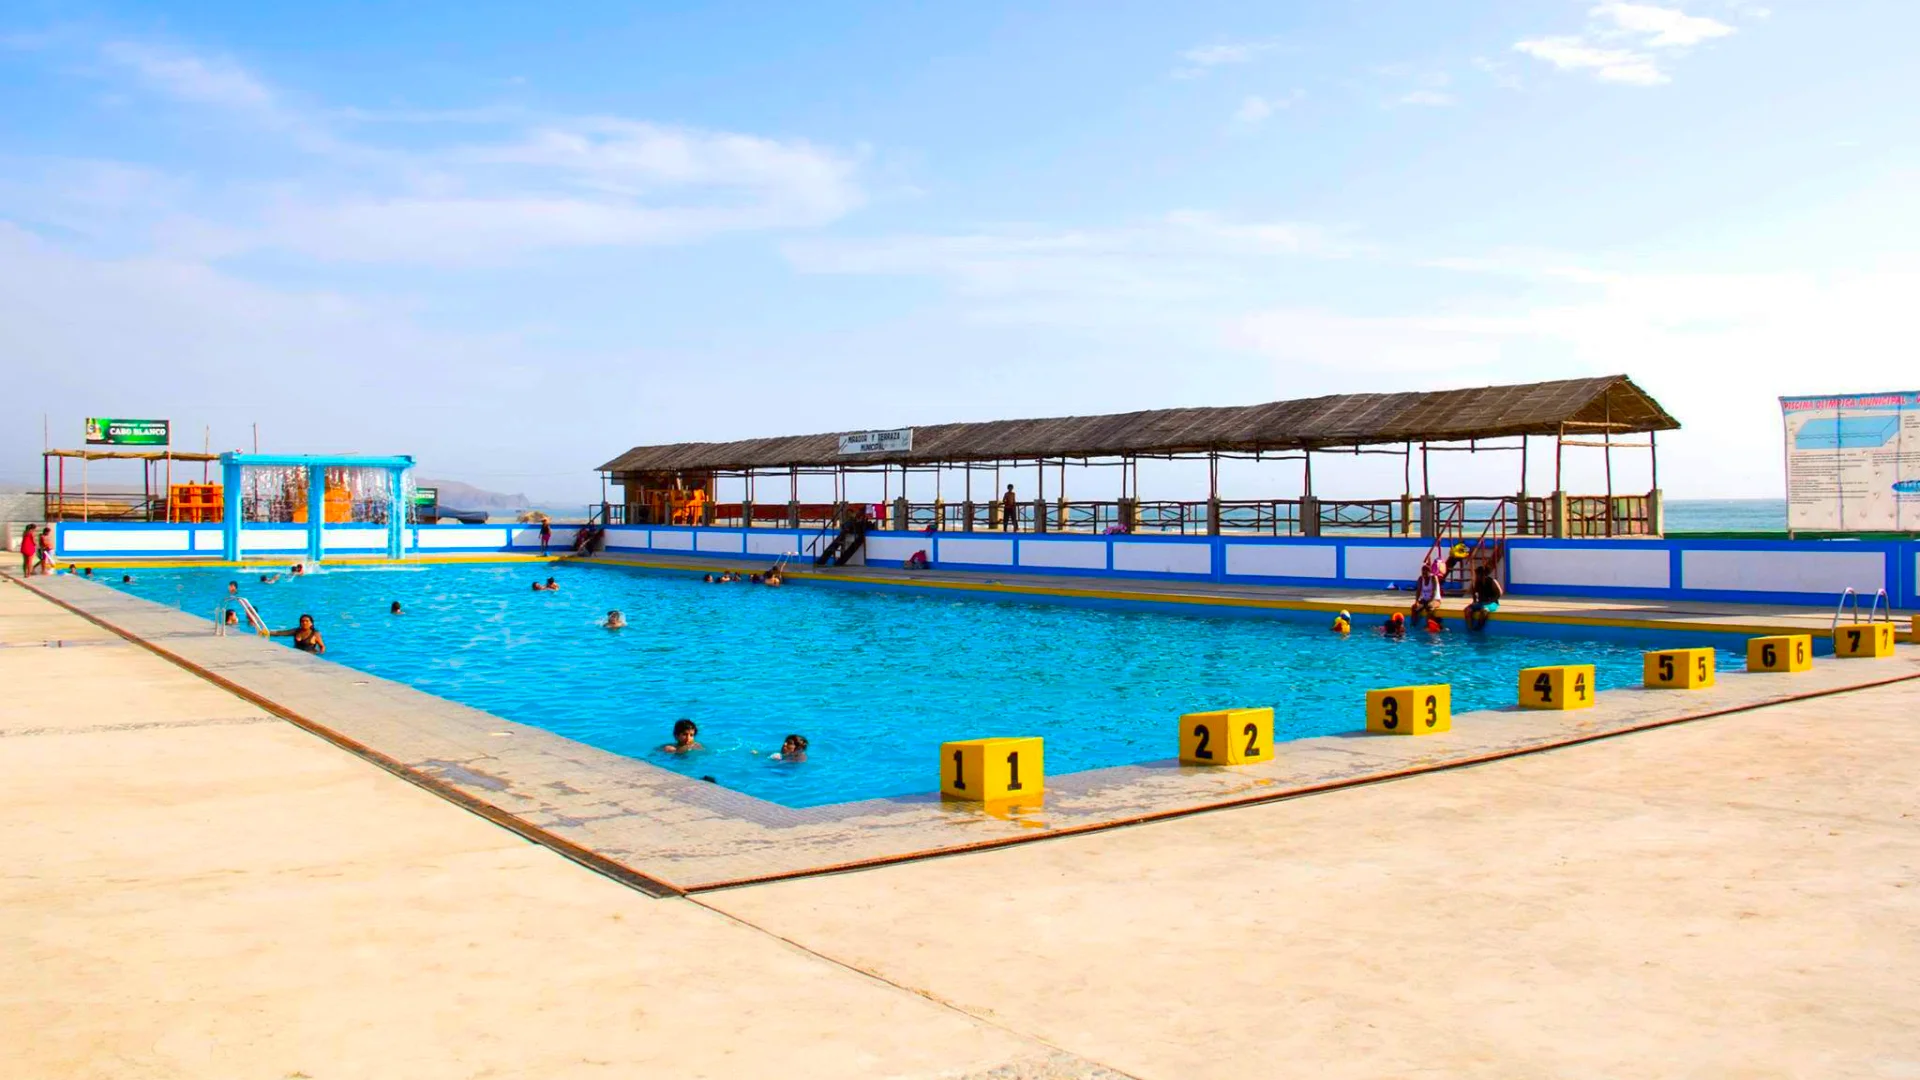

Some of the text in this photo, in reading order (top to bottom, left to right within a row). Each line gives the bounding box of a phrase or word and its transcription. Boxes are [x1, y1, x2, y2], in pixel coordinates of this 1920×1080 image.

[109, 428, 167, 436] CABO BLANCO
[878, 432, 900, 441] TERRAZA
[1796, 641, 1804, 665] 6
[1847, 630, 1861, 652] 7
[1882, 628, 1889, 650] 7
[1658, 655, 1674, 682] 5
[1697, 656, 1707, 682] 5
[1761, 643, 1777, 668] 6
[1533, 672, 1552, 702] 4
[1574, 672, 1586, 701] 4
[1382, 696, 1399, 729] 3
[1425, 695, 1437, 728] 3
[1193, 724, 1213, 760] 2
[1243, 722, 1261, 757] 2
[952, 750, 966, 791] 1
[1006, 751, 1022, 791] 1
